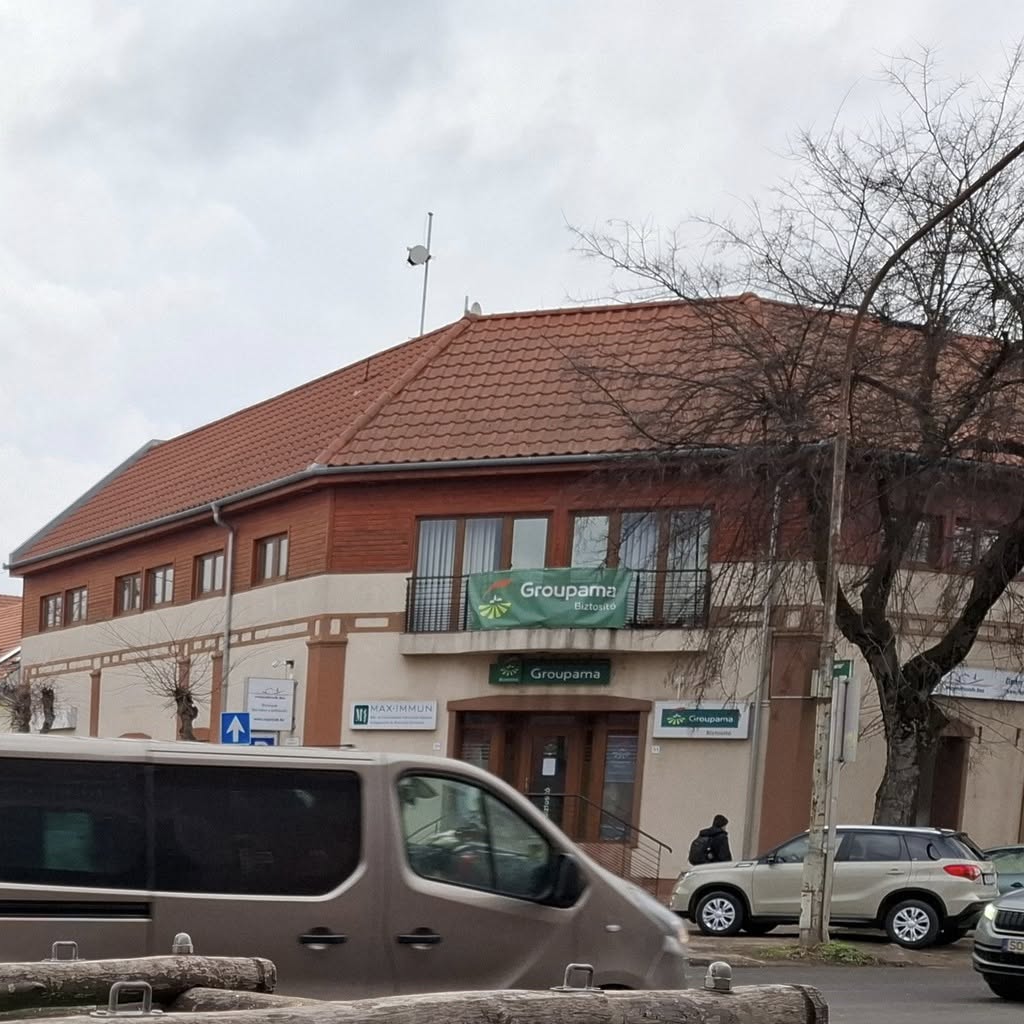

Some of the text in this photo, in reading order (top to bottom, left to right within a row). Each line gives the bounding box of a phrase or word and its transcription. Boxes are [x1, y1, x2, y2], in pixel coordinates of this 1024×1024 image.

[520, 581, 616, 600] Groupama
[574, 601, 617, 611] Biztosító
[530, 668, 601, 682] Groupama
[688, 714, 734, 724] Groupama
